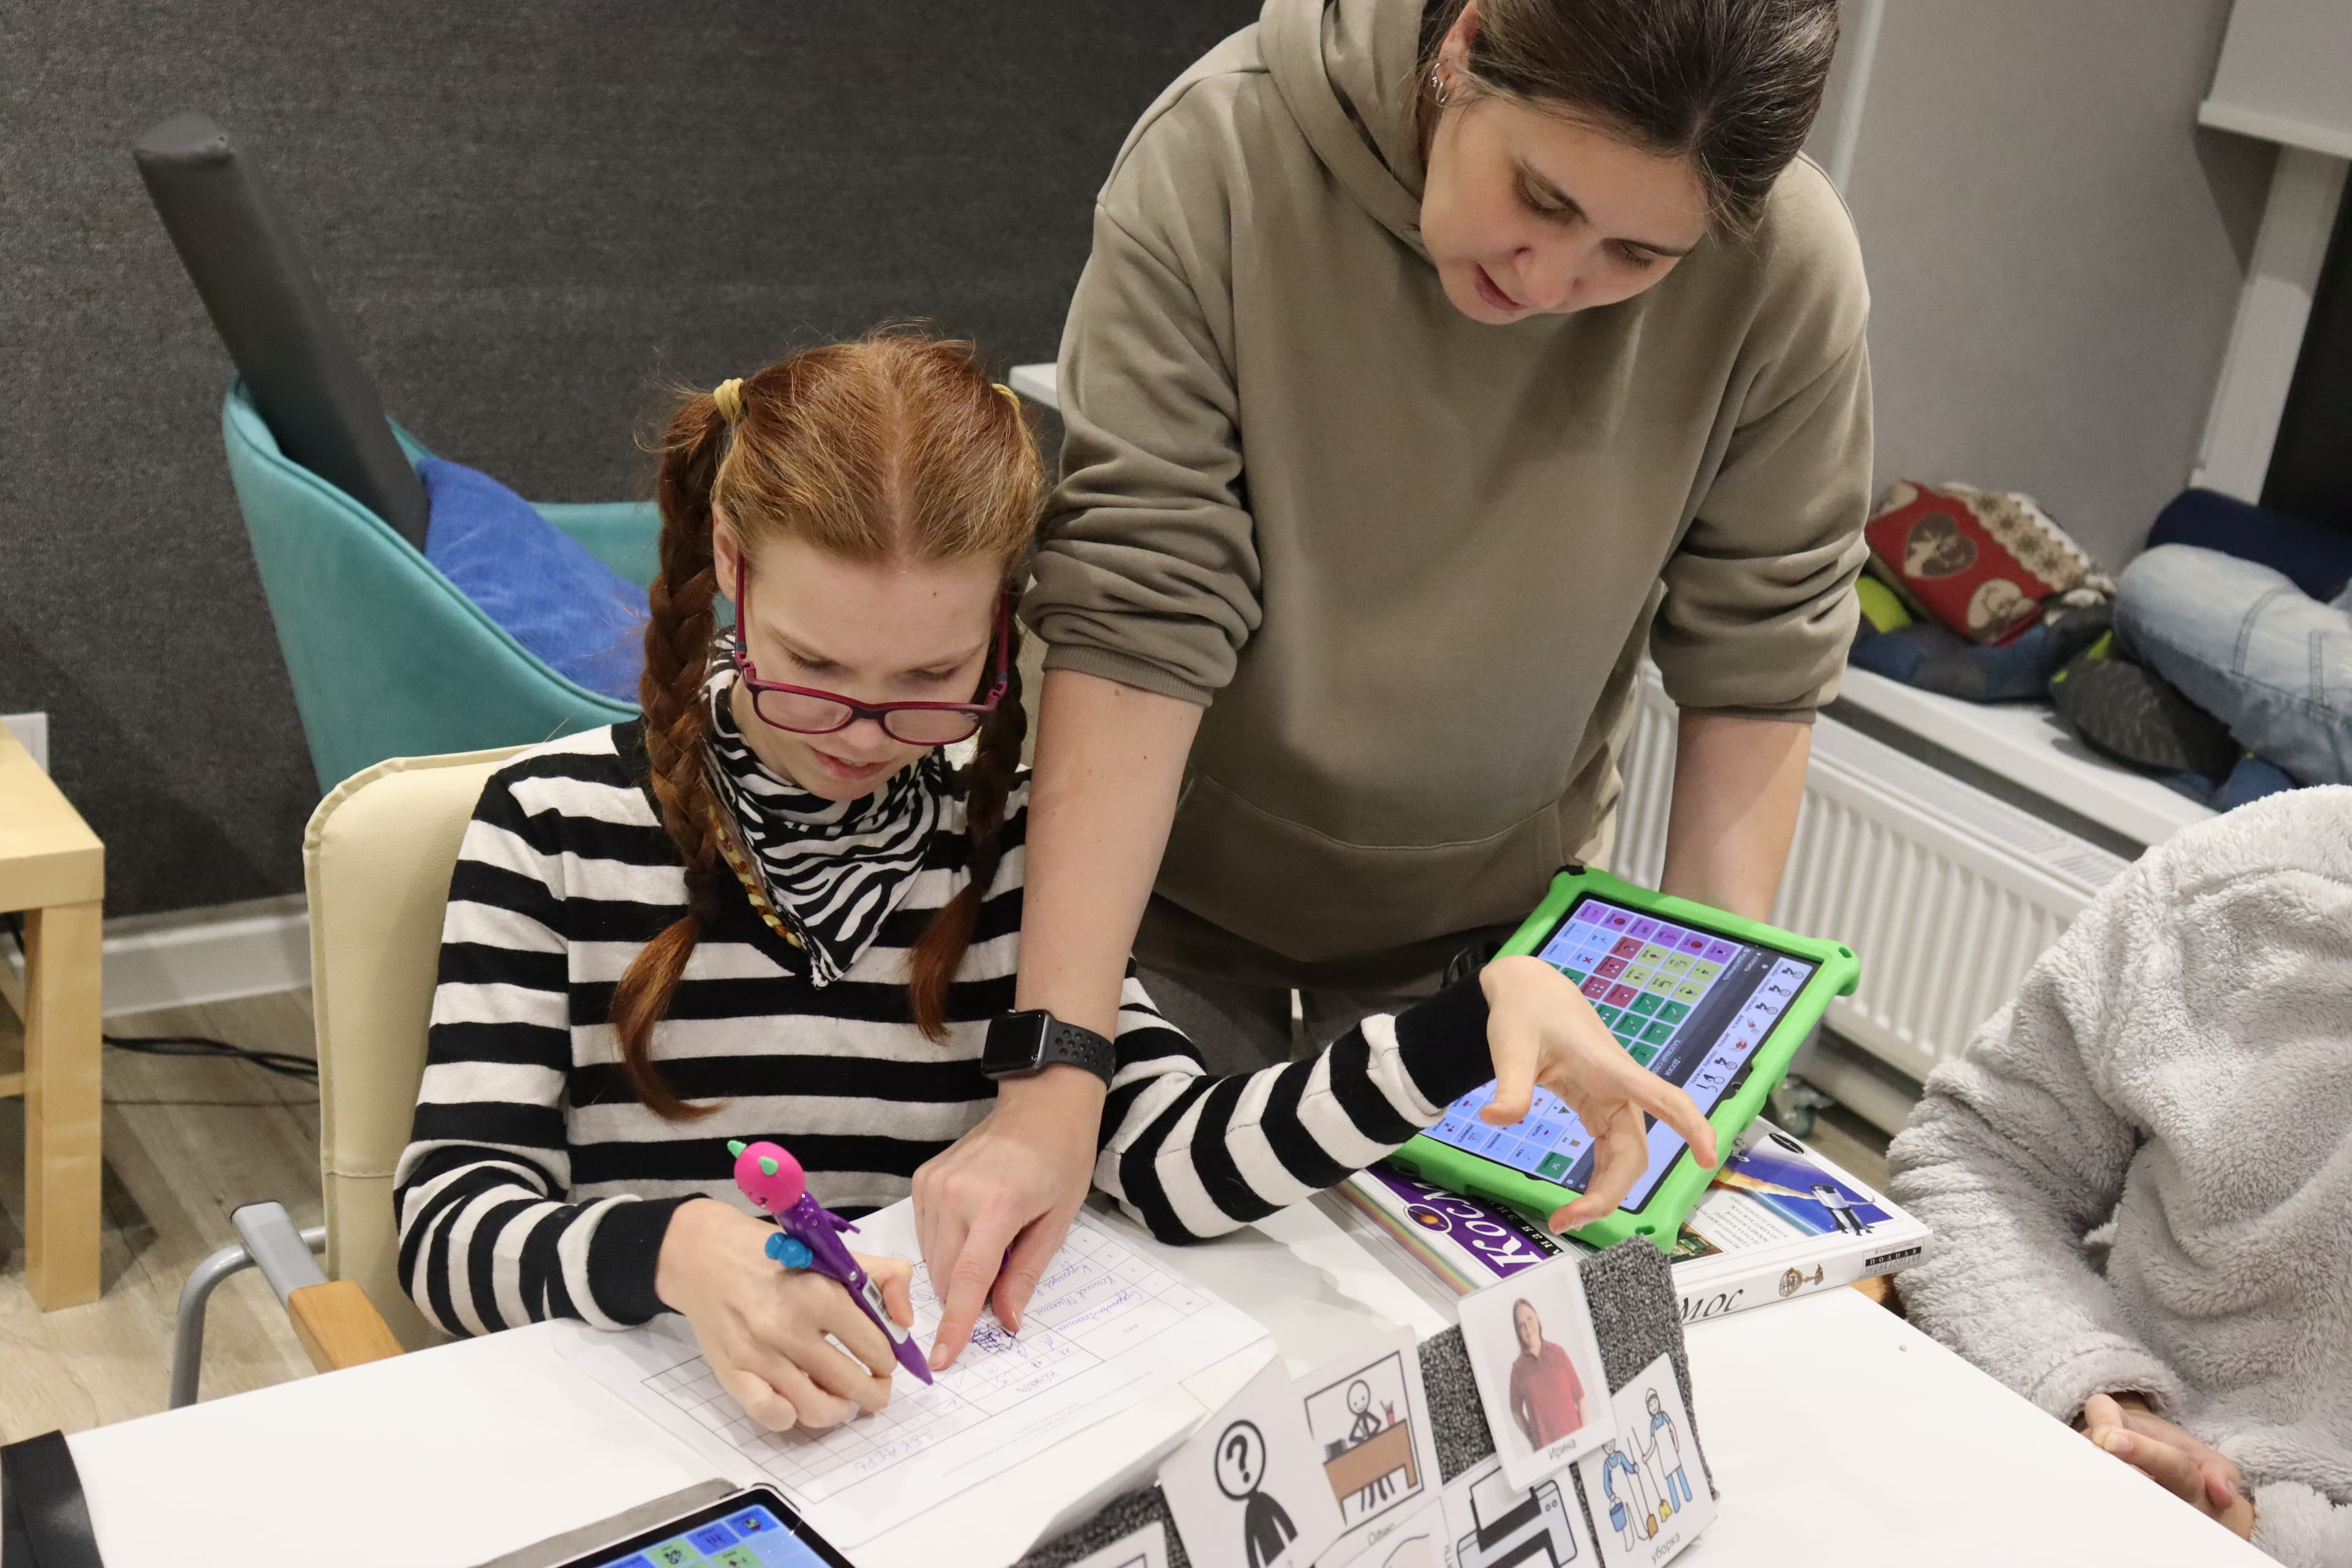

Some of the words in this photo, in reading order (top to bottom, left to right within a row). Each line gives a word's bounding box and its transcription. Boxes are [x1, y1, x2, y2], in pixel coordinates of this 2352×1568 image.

[1660, 1039, 1681, 1062] БАЗОВЫЙ
[1530, 1123, 1544, 1137] здесь
[1514, 1148, 1525, 1158] там
[1870, 1248, 1917, 1265] ПОЛНАЯ
[1548, 1439, 1577, 1460] Ирина
[1651, 1532, 1681, 1565] уборка
